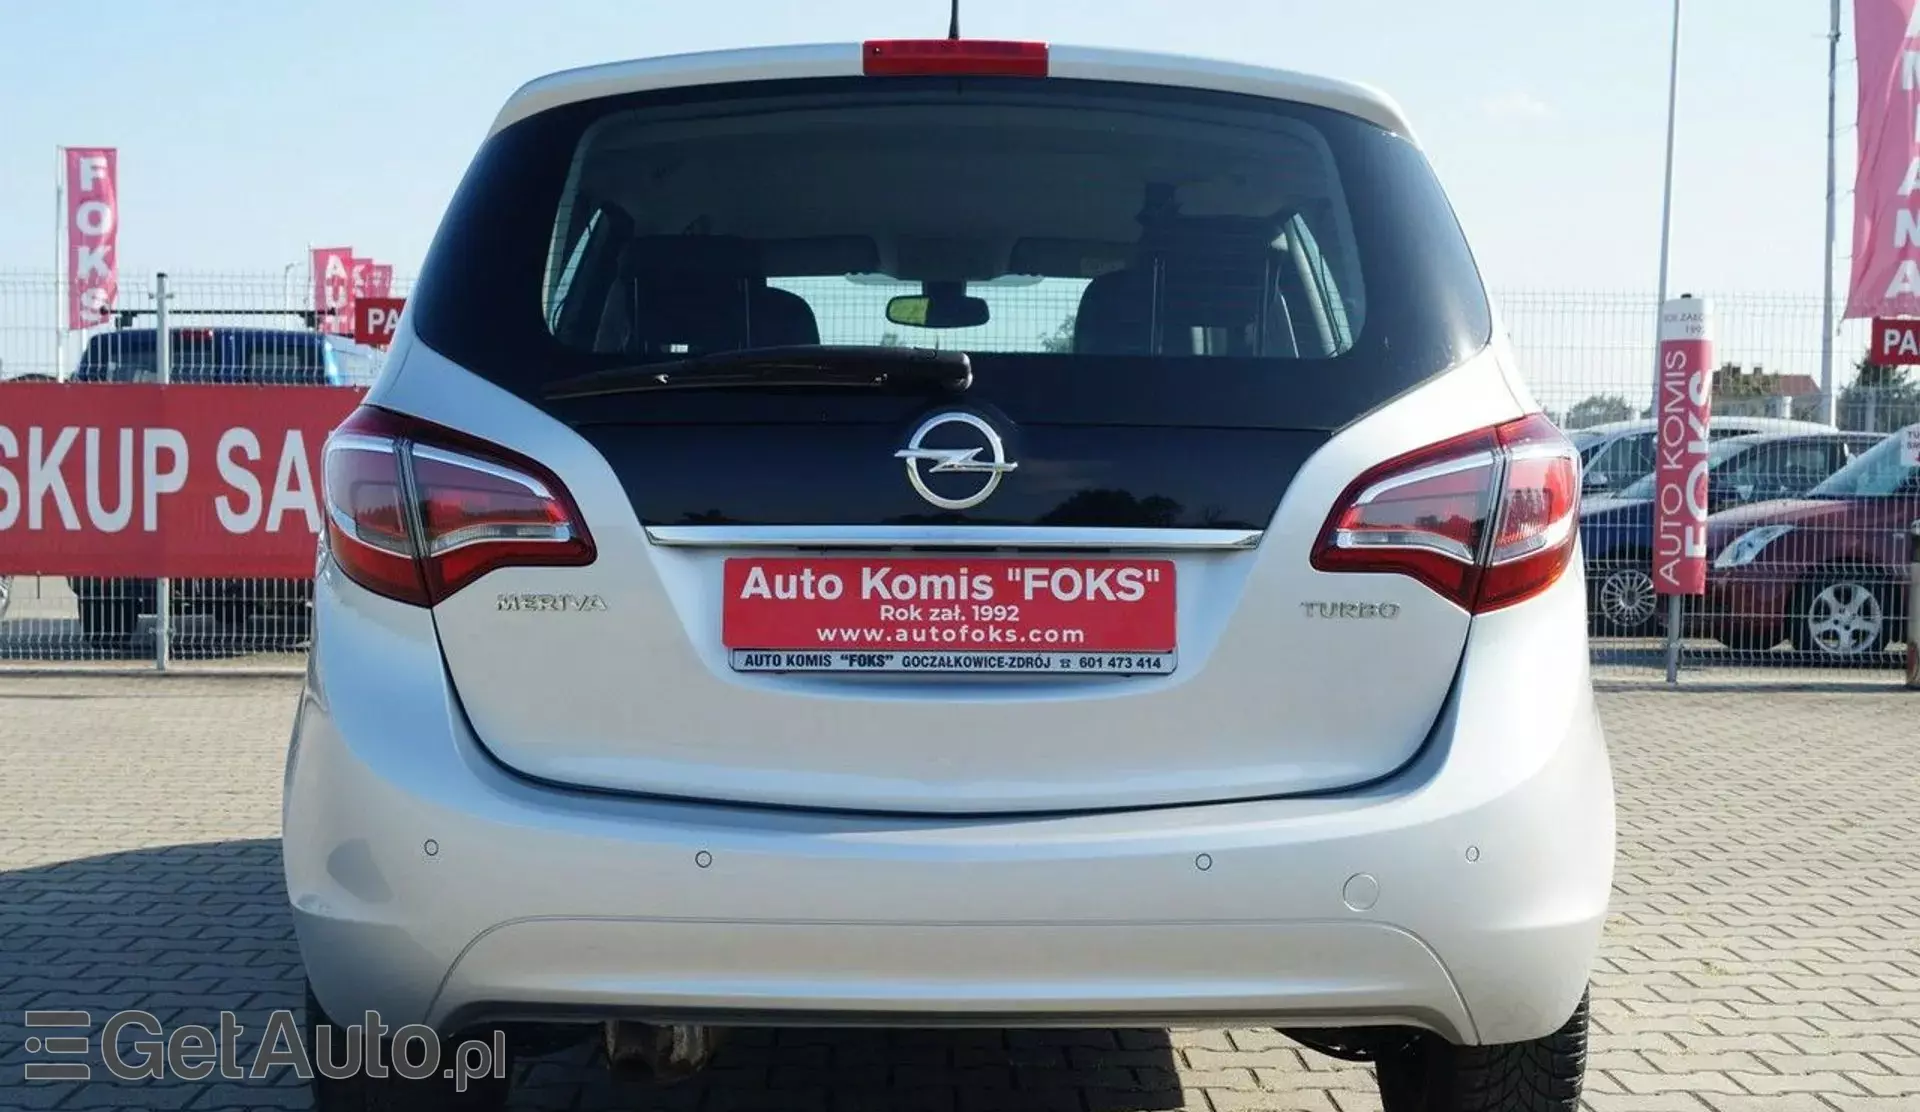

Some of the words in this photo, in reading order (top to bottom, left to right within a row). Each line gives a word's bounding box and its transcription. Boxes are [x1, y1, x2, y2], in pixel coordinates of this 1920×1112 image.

[76, 156, 113, 321] FOKS
[1884, 329, 1920, 355] PA
[1662, 350, 1687, 470] KOMIS
[1685, 369, 1712, 558] FOKS
[214, 427, 338, 533] SA
[1659, 483, 1683, 586] AUTO
[740, 566, 844, 601] Auto
[861, 566, 994, 601] Komis
[1007, 567, 1160, 602] "FOKS"
[496, 593, 608, 612] MERIVA
[880, 604, 922, 622] Rok
[929, 604, 966, 622] zał.
[971, 605, 1020, 622] 1992
[1300, 601, 1400, 619] TURBO
[816, 625, 1085, 643] www.autofoks.com
[744, 654, 782, 668] AUTO
[786, 654, 832, 668] KOMIS
[902, 653, 1051, 670] GOCZAŁKOWICE-ZDRÓJ
[1079, 656, 1103, 669] 601
[1108, 656, 1133, 669] 473
[1136, 656, 1162, 669] 414
